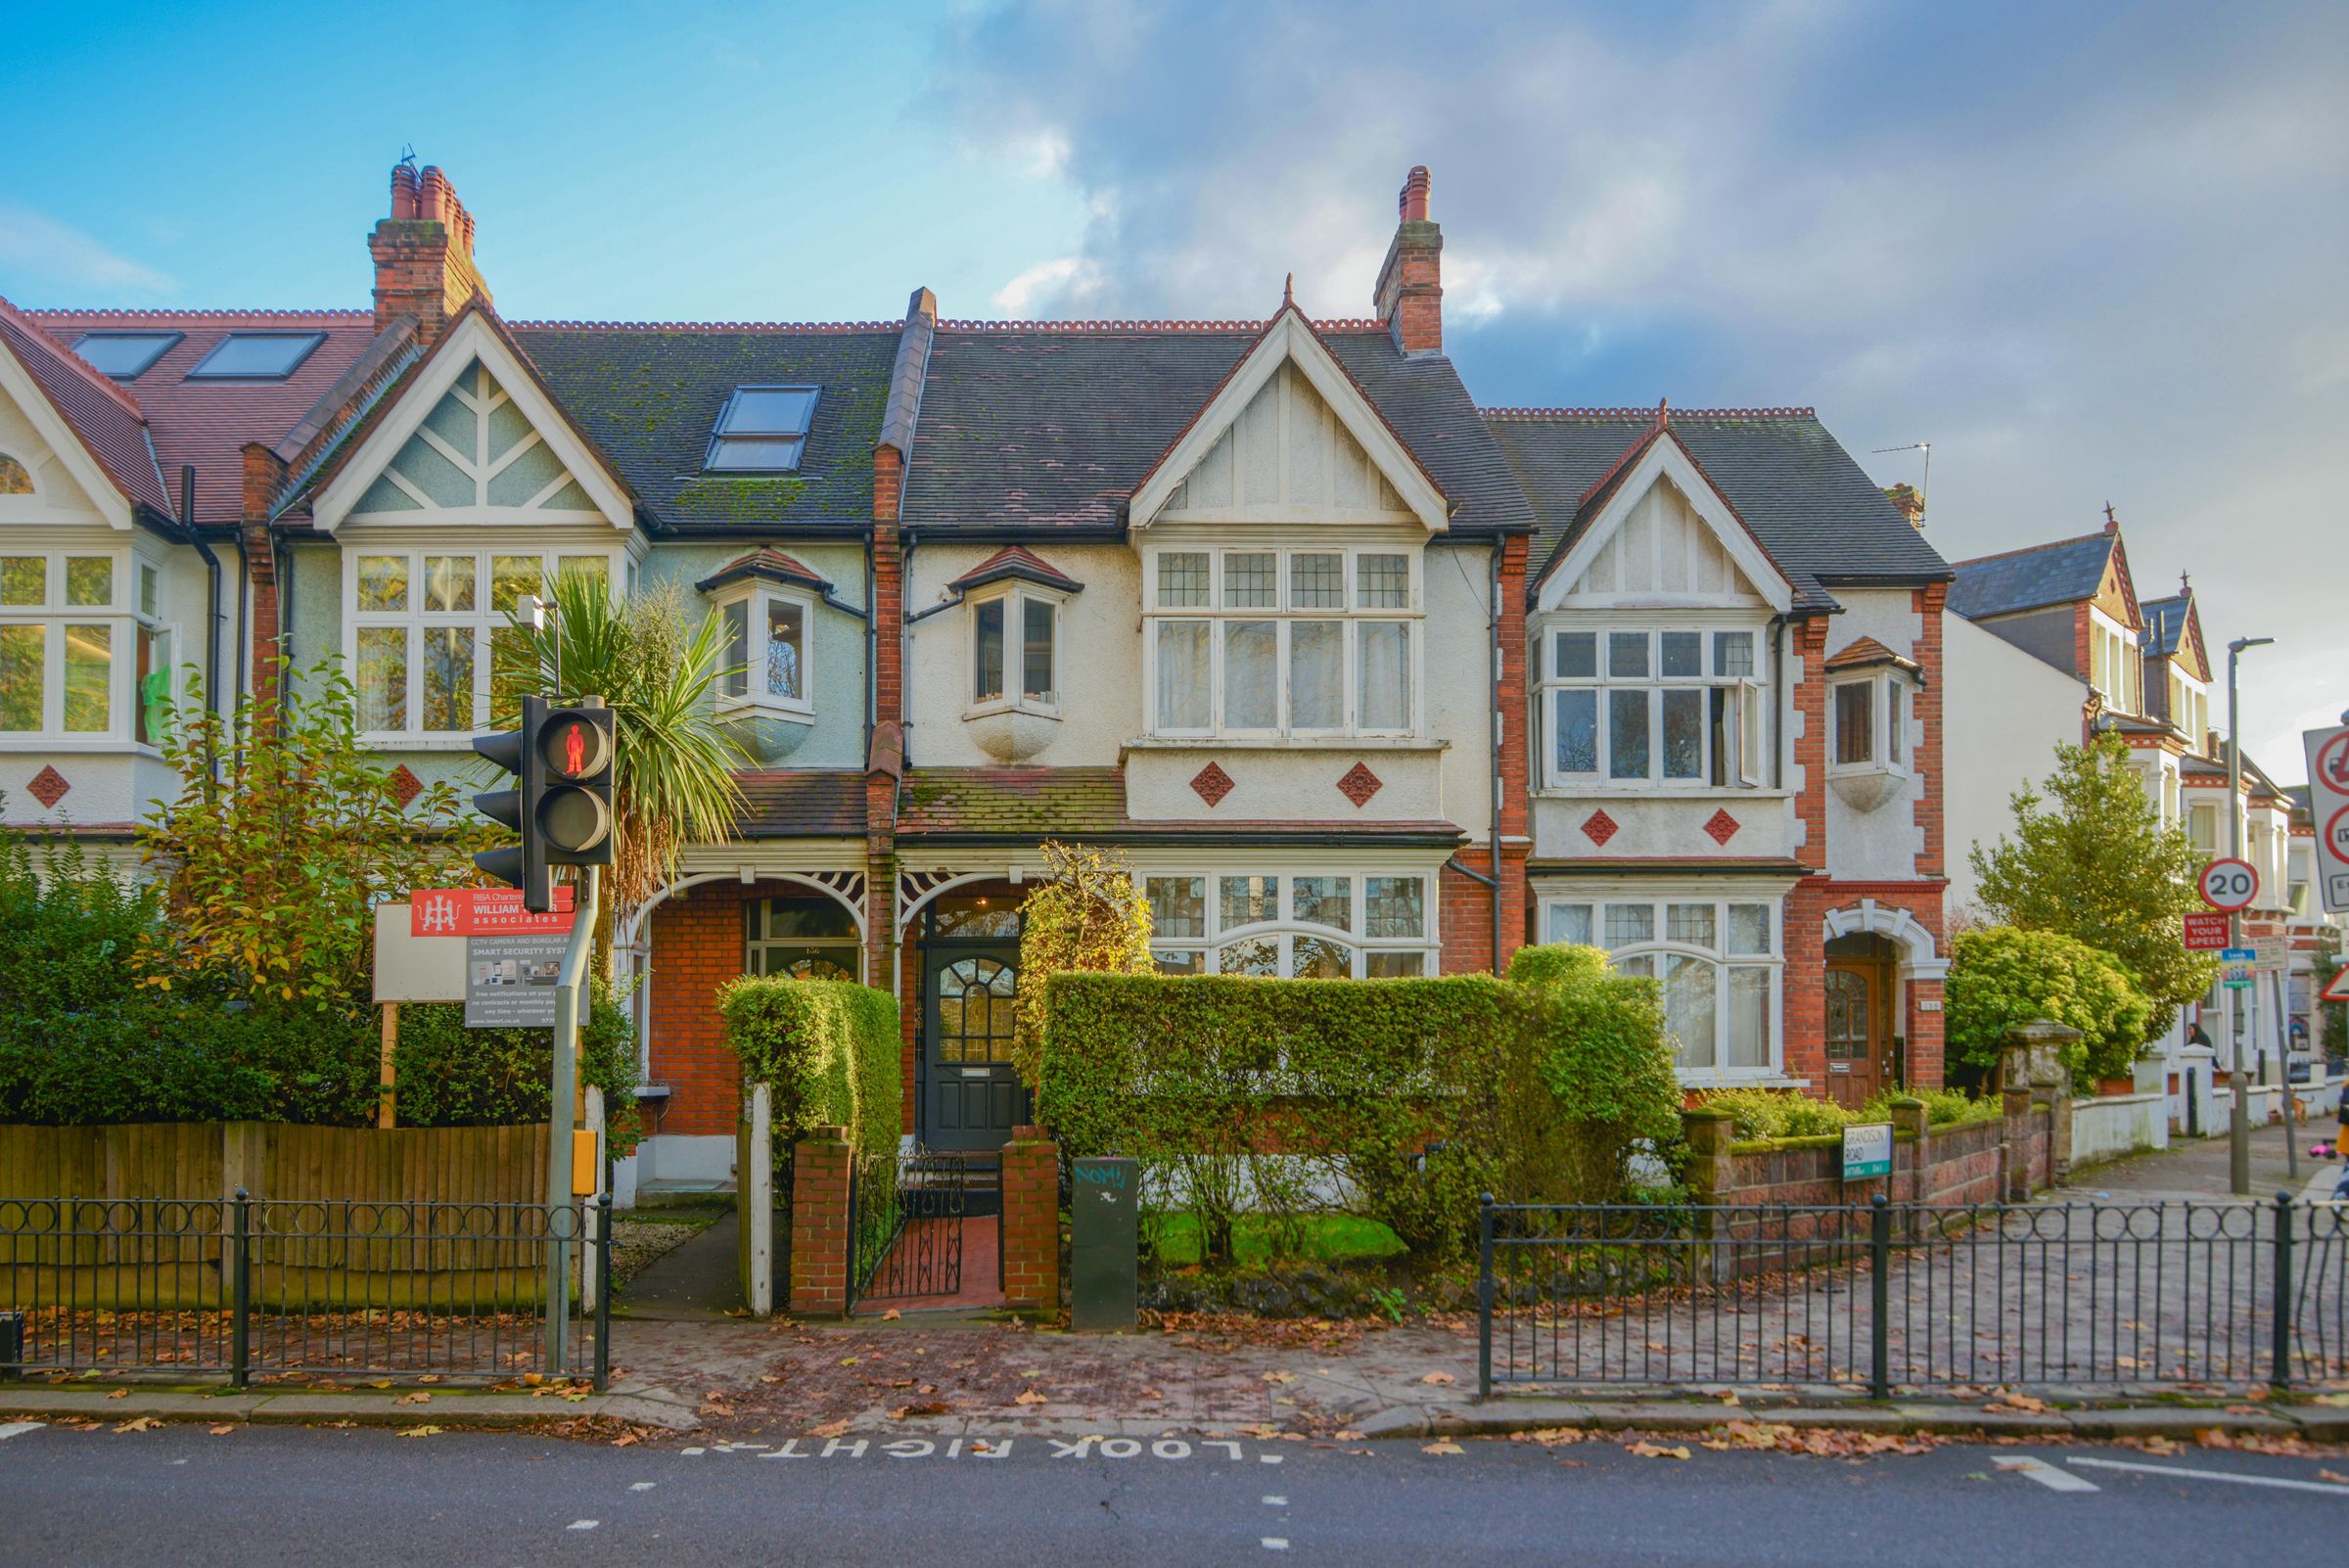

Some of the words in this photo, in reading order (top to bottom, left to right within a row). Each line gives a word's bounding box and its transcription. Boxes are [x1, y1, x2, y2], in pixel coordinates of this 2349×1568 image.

[2210, 873, 2250, 895] 20
[473, 893, 490, 901] RIBA
[492, 893, 526, 901] Chartere
[474, 903, 519, 914] WILLIAM
[473, 914, 558, 924] associates
[2188, 916, 2227, 926] WATCH
[2191, 927, 2223, 936] YOUR
[2188, 937, 2226, 945] SPEED
[472, 947, 501, 956] SMART
[502, 946, 544, 955] SECURITY
[758, 1438, 1014, 1458] RIGHT
[1048, 1439, 1243, 1459] LOOK
